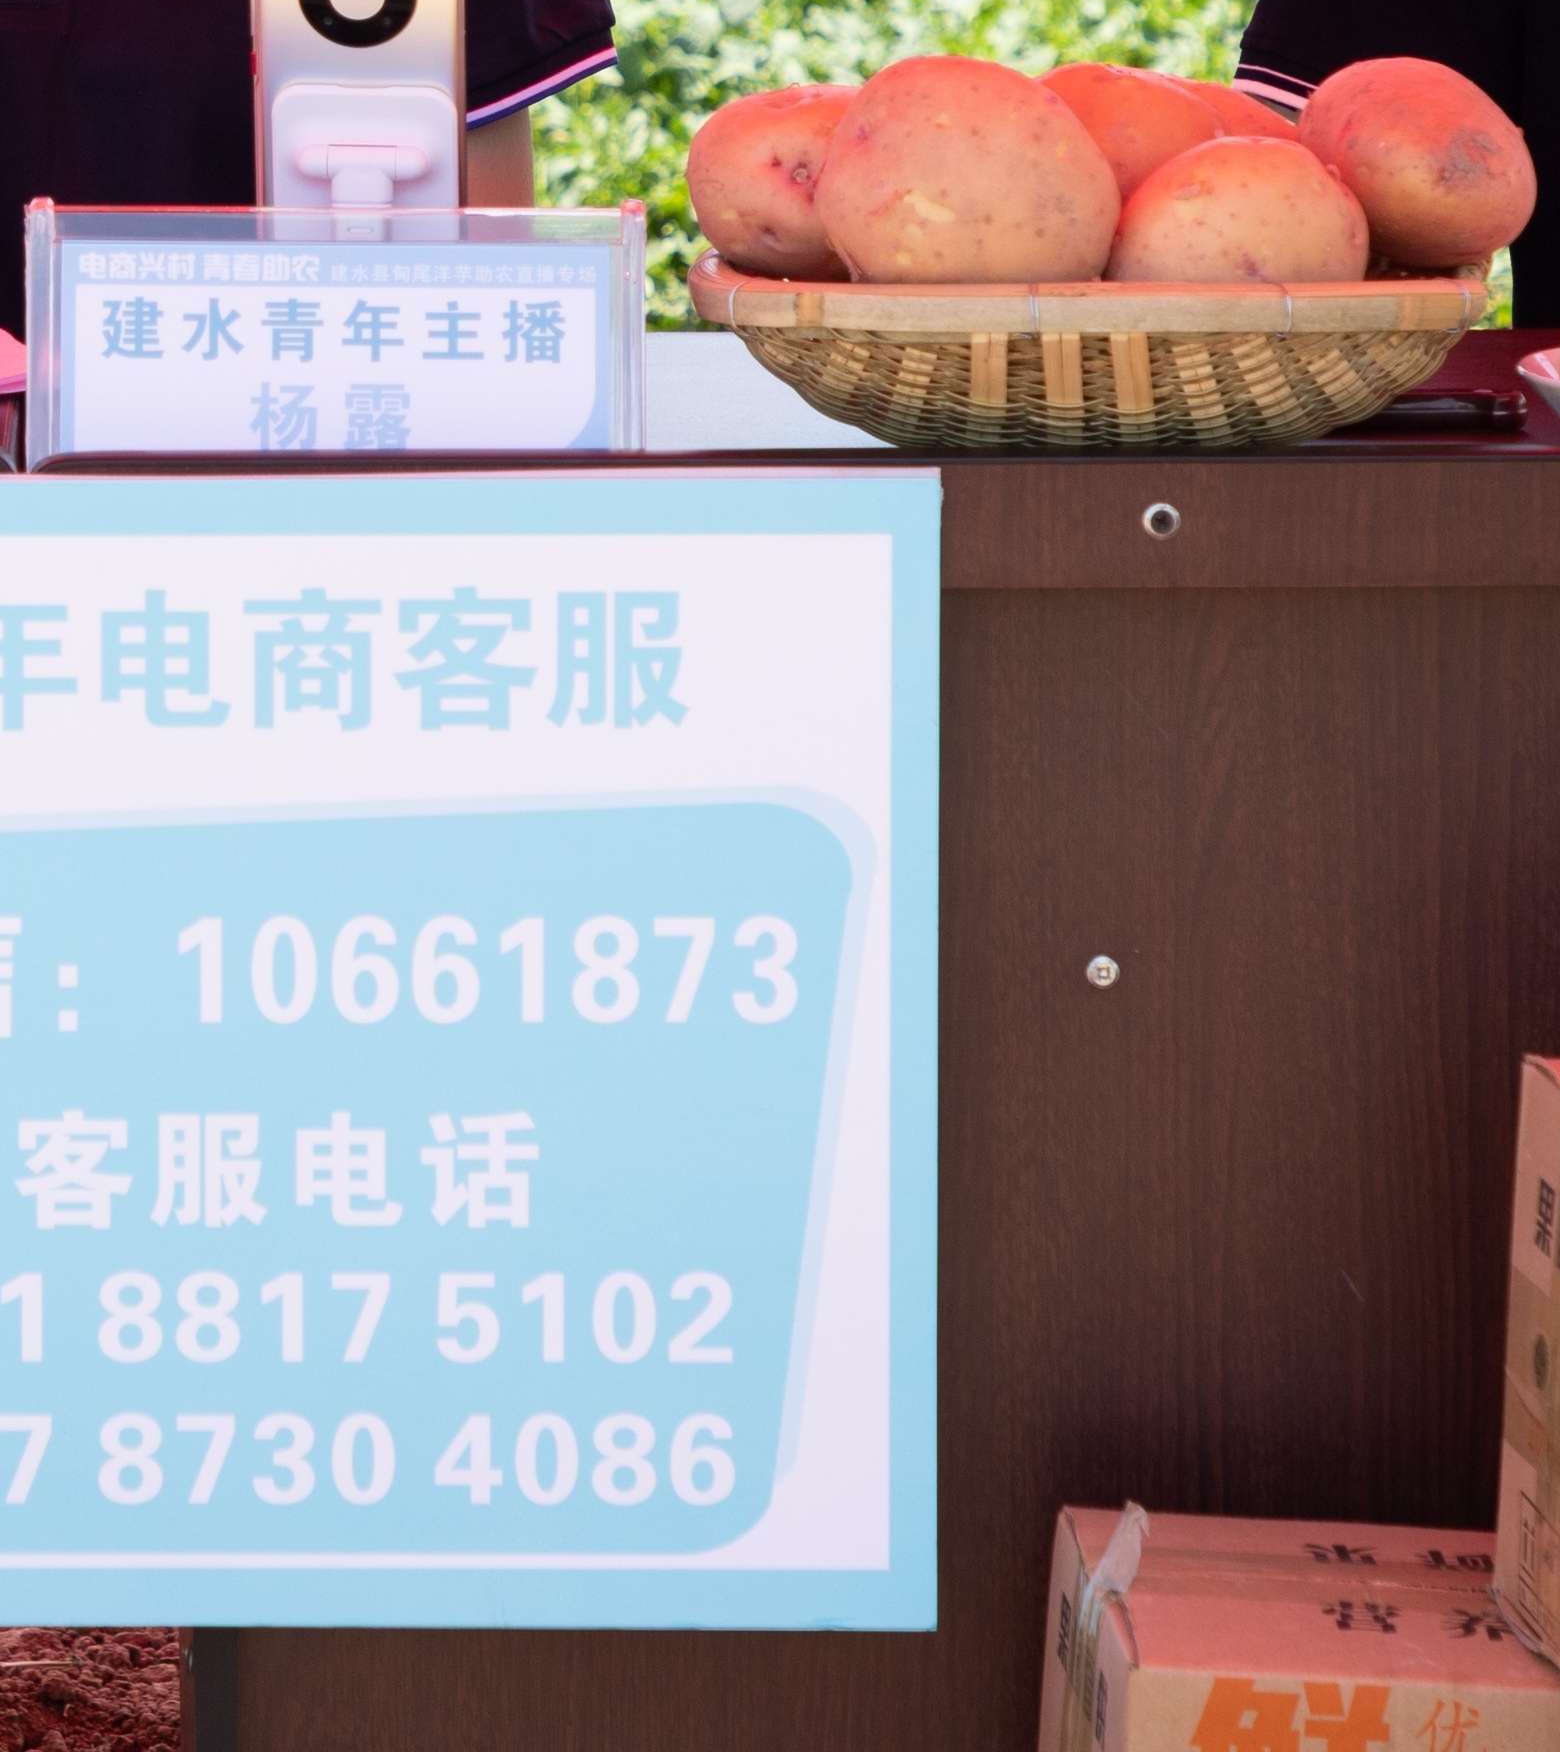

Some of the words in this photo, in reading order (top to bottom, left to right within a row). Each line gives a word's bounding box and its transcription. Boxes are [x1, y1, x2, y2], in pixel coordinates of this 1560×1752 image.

[78, 252, 195, 281] 电商兴村
[203, 252, 321, 282] 青春助农
[100, 296, 567, 365] 建水青年主播
[249, 382, 412, 451] 杨露
[176, 915, 800, 1028] 10661873
[13, 1110, 541, 1230] 客服电话
[97, 1271, 391, 1365] 8817
[435, 1271, 734, 1365] 5102
[97, 1415, 395, 1508] 8730
[433, 1415, 736, 1508] 4086
